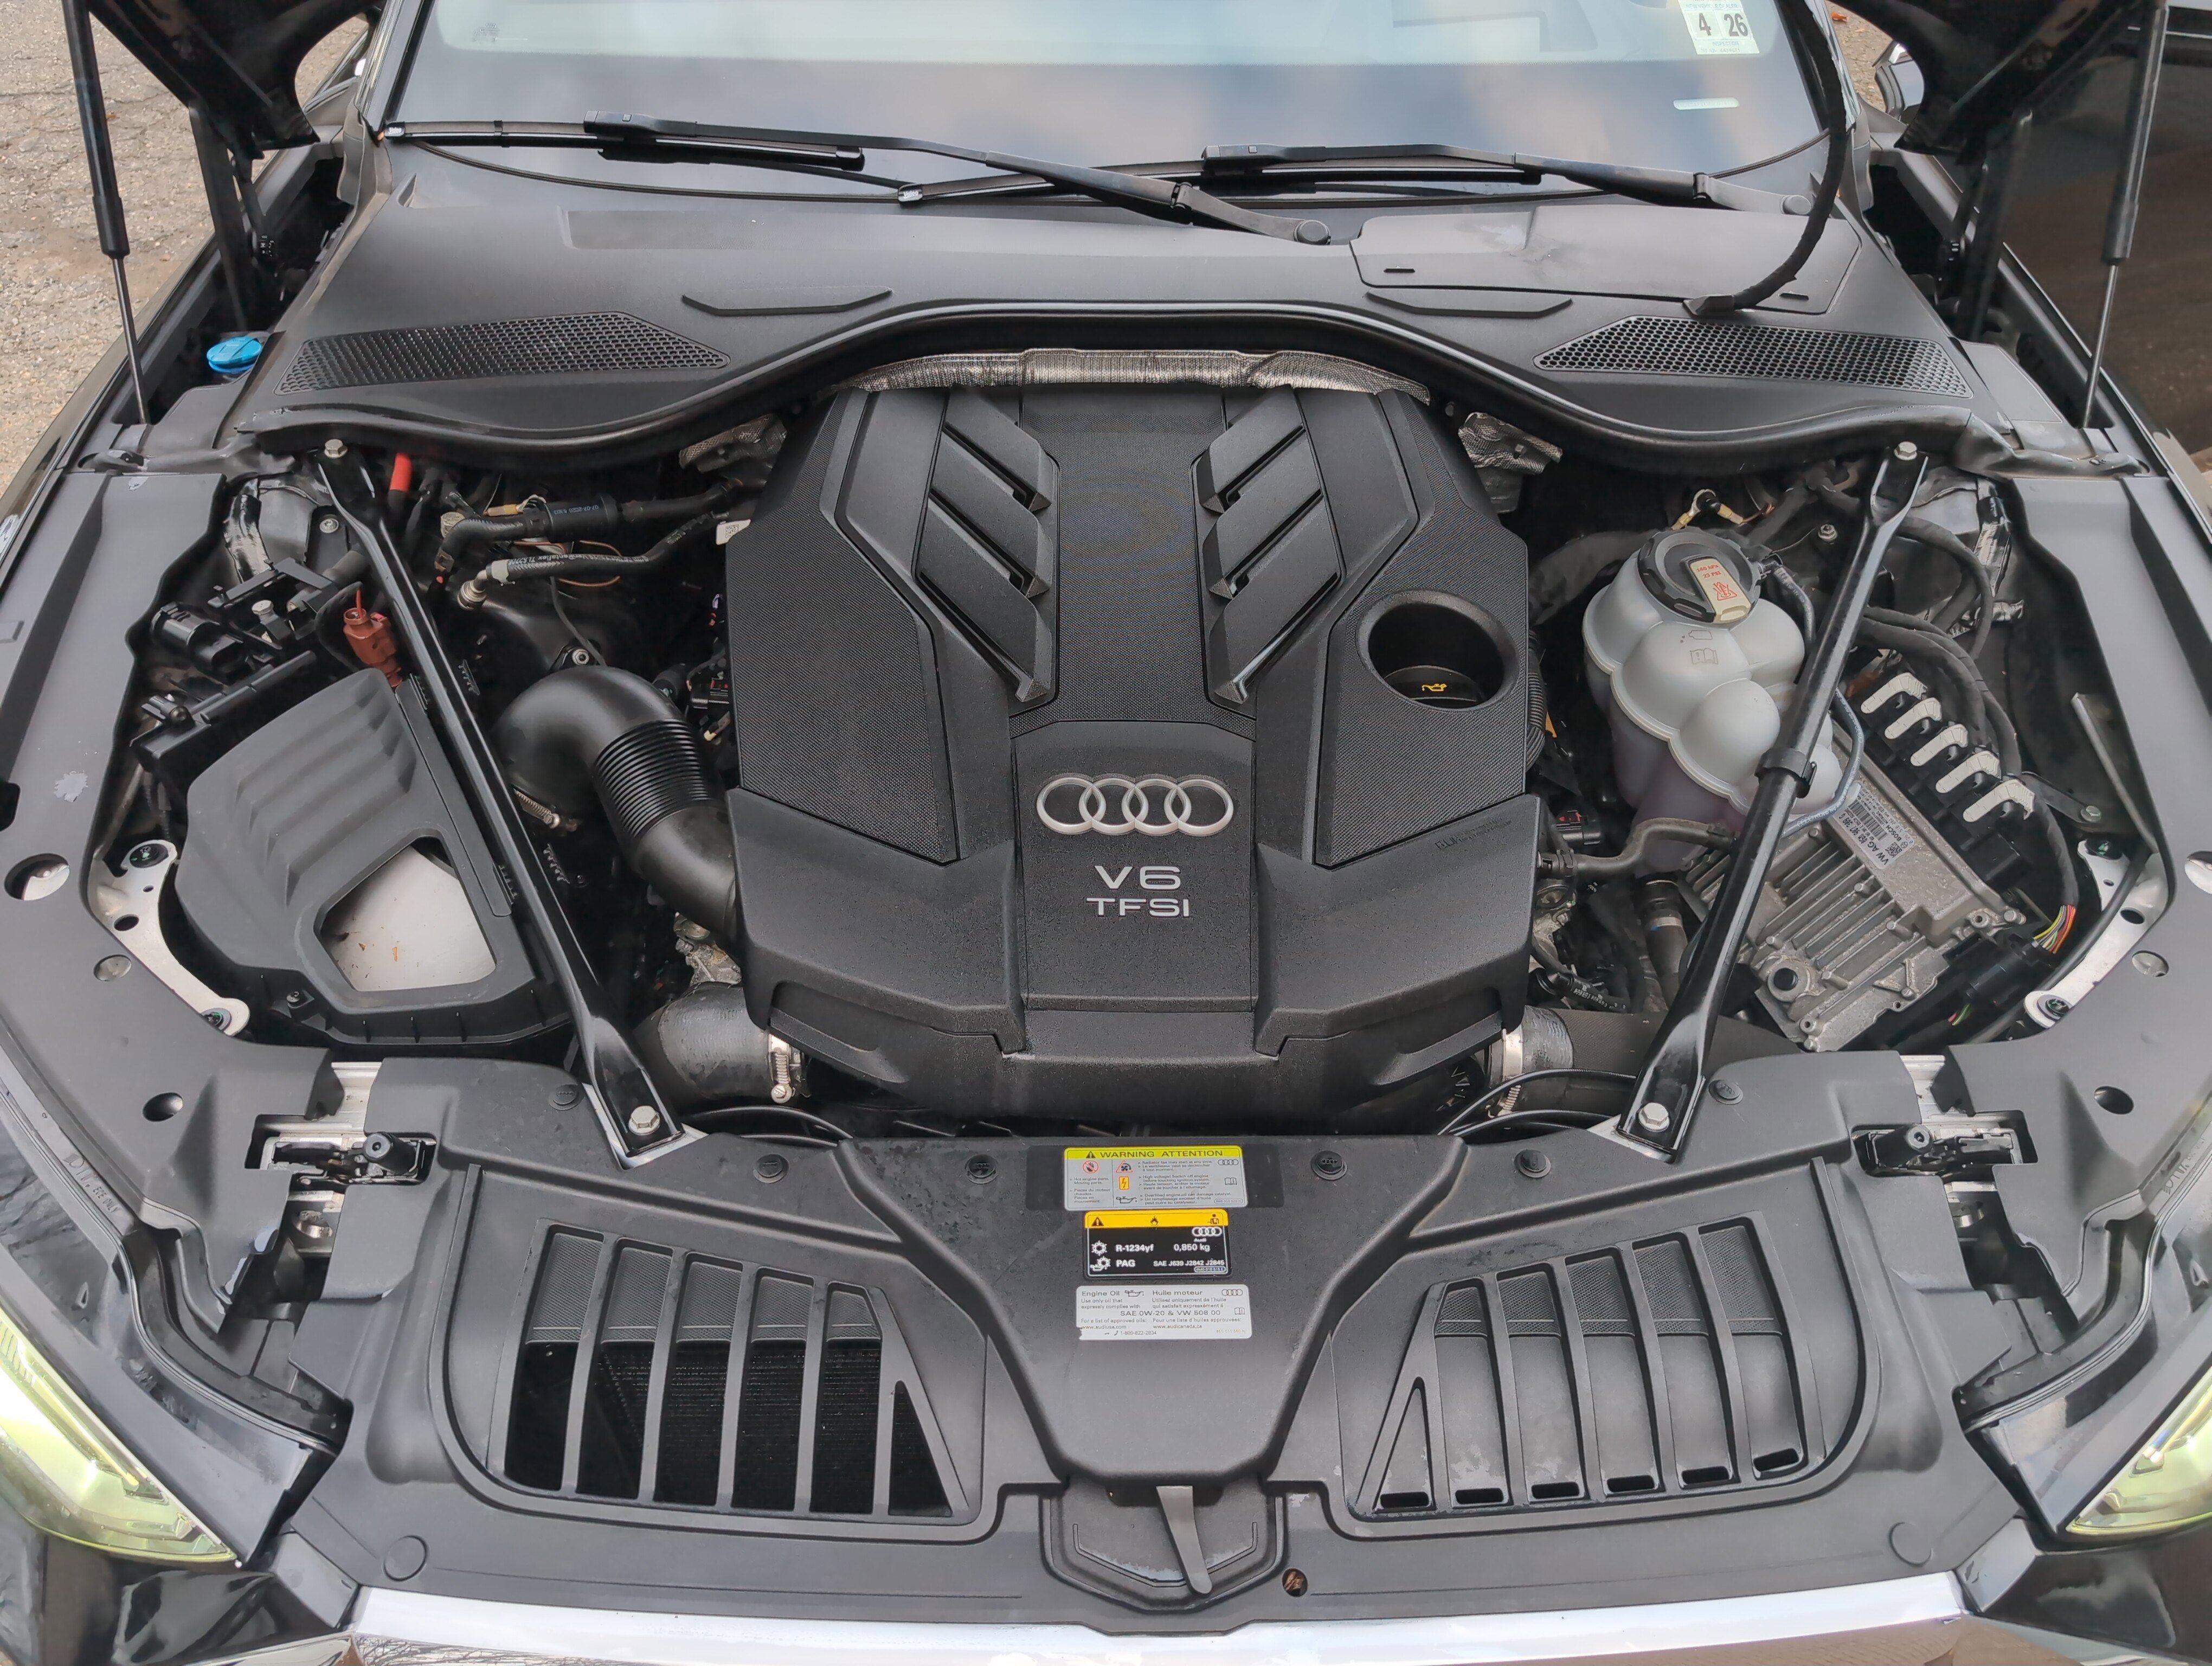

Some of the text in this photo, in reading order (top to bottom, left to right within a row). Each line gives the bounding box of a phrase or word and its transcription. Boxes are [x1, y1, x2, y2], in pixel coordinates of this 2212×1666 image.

[1699, 13, 1748, 36] 4 26
[1886, 824, 1901, 842] BOSCH
[1867, 841, 1880, 852] AG
[1876, 852, 1889, 866] VW
[1094, 865, 1181, 890] V6
[1086, 898, 1189, 917] TFSI
[93, 1186, 107, 1199] ECE
[1115, 1243, 1211, 1253] R-1234yf 0,850 kg
[1116, 1259, 1136, 1267] PAG
